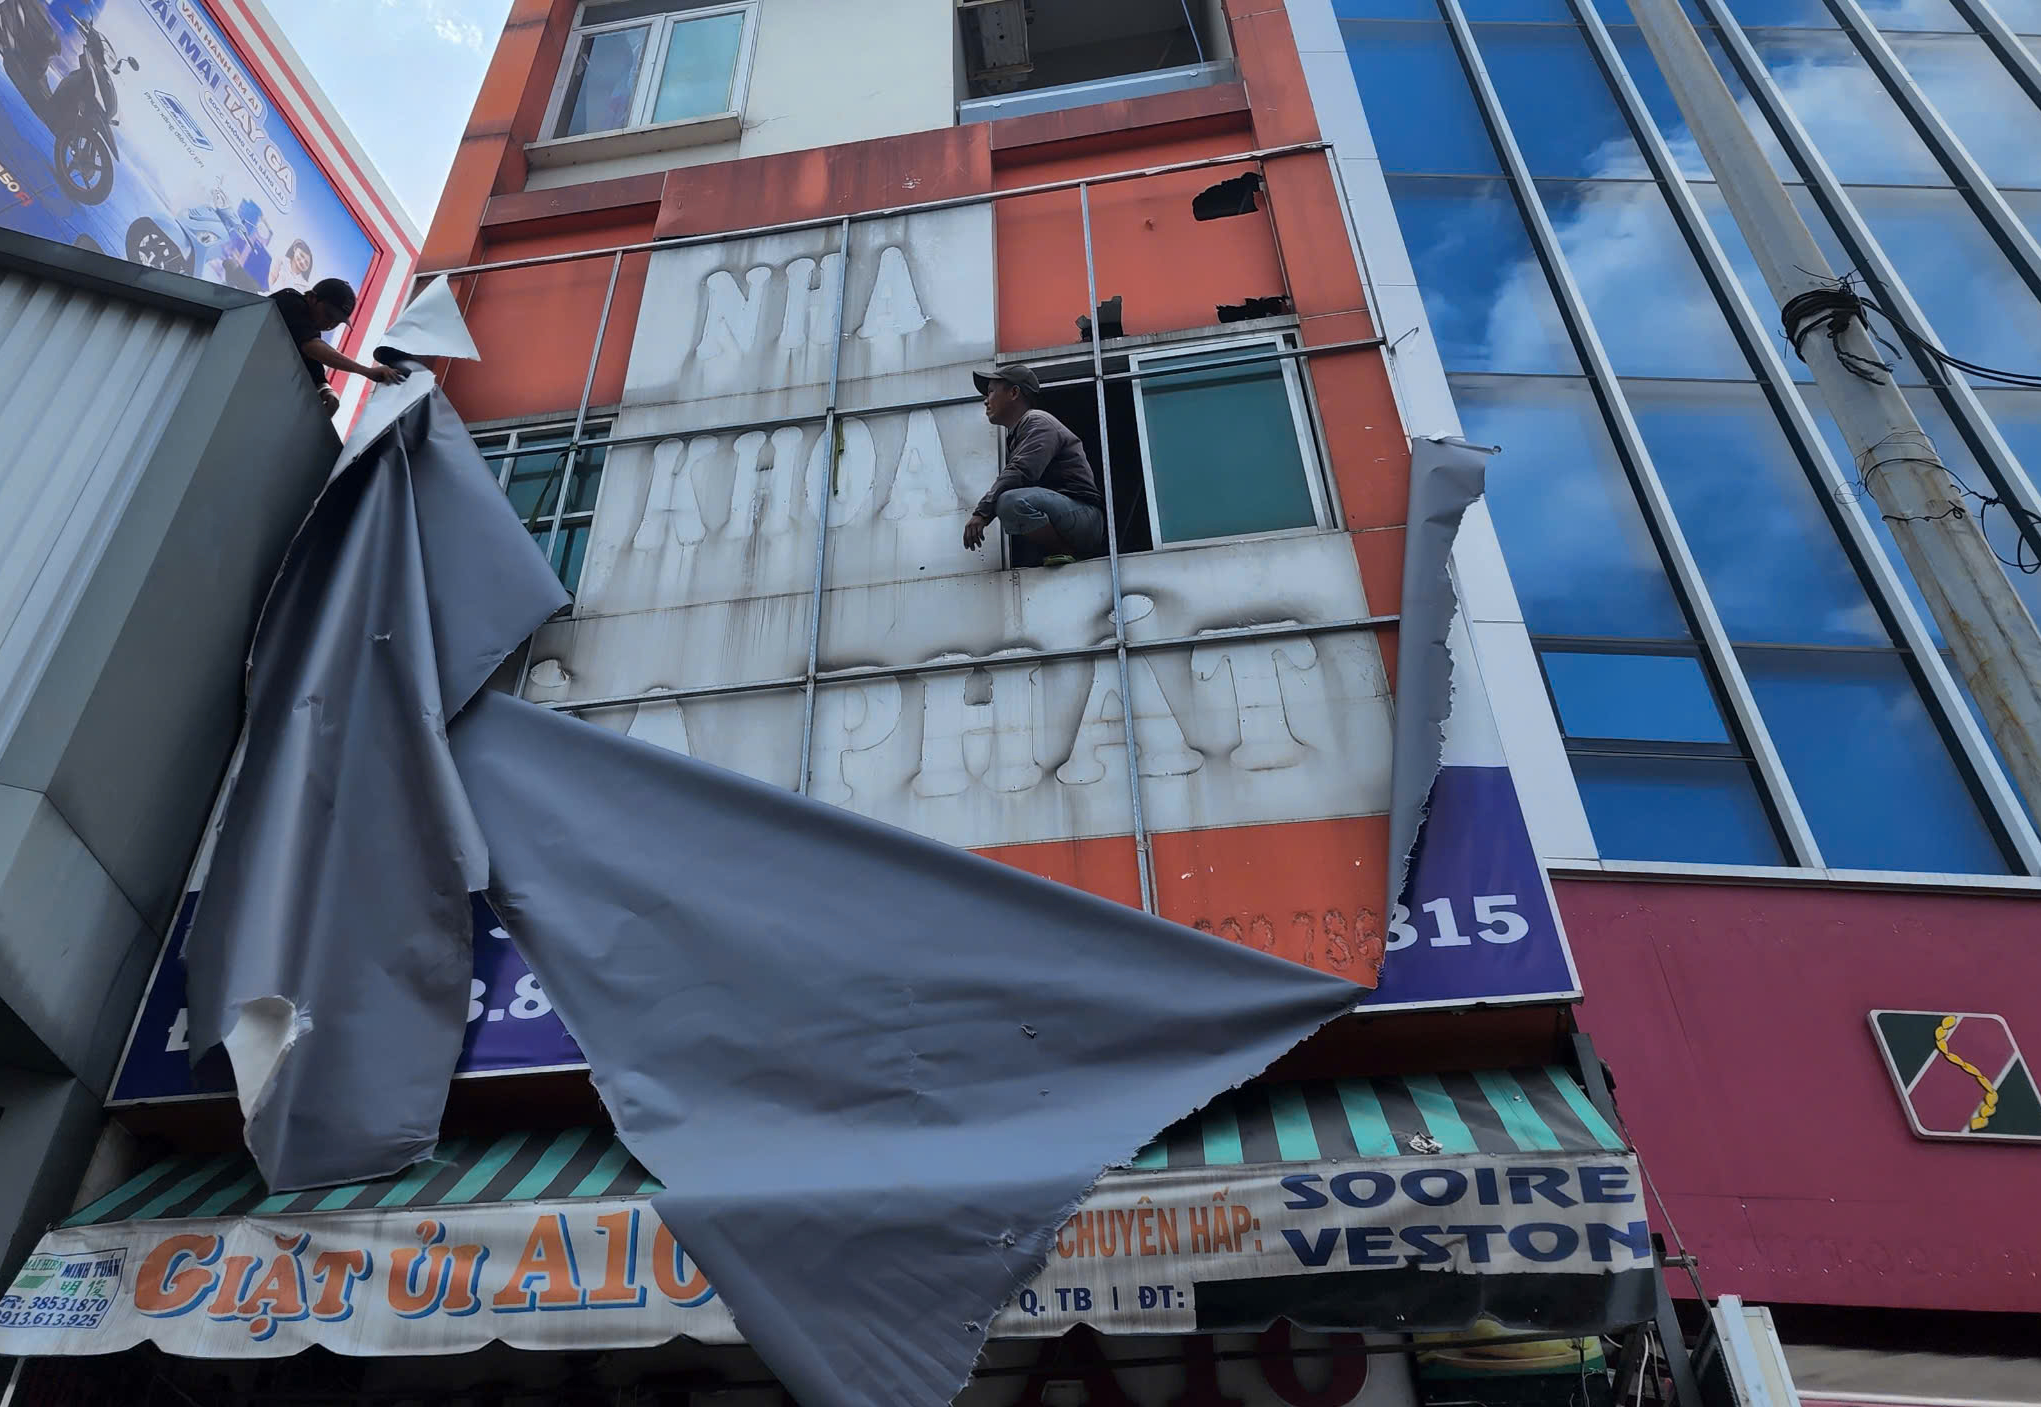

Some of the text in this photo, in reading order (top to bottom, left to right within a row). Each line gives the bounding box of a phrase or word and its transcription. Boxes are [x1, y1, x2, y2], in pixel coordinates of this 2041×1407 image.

[178, 30, 221, 90] MÁI
[223, 84, 266, 144] TAY
[263, 144, 293, 194] GA
[633, 408, 963, 550] KHOA
[1279, 1166, 1638, 1211] SOOIRE
[1056, 1187, 1263, 1259] CHUYÊN HẤP:
[1280, 1219, 1655, 1268] VESTON
[60, 1261, 93, 1279] MINH
[134, 1232, 373, 1341] GIẶT
[388, 1219, 491, 1319] ỦI
[0, 1311, 100, 1327] 913.613.925
[28, 1296, 109, 1312] 38531870
[1018, 1287, 1046, 1315] Q.
[1055, 1287, 1093, 1312] TB
[1137, 1285, 1186, 1310] ĐT:
